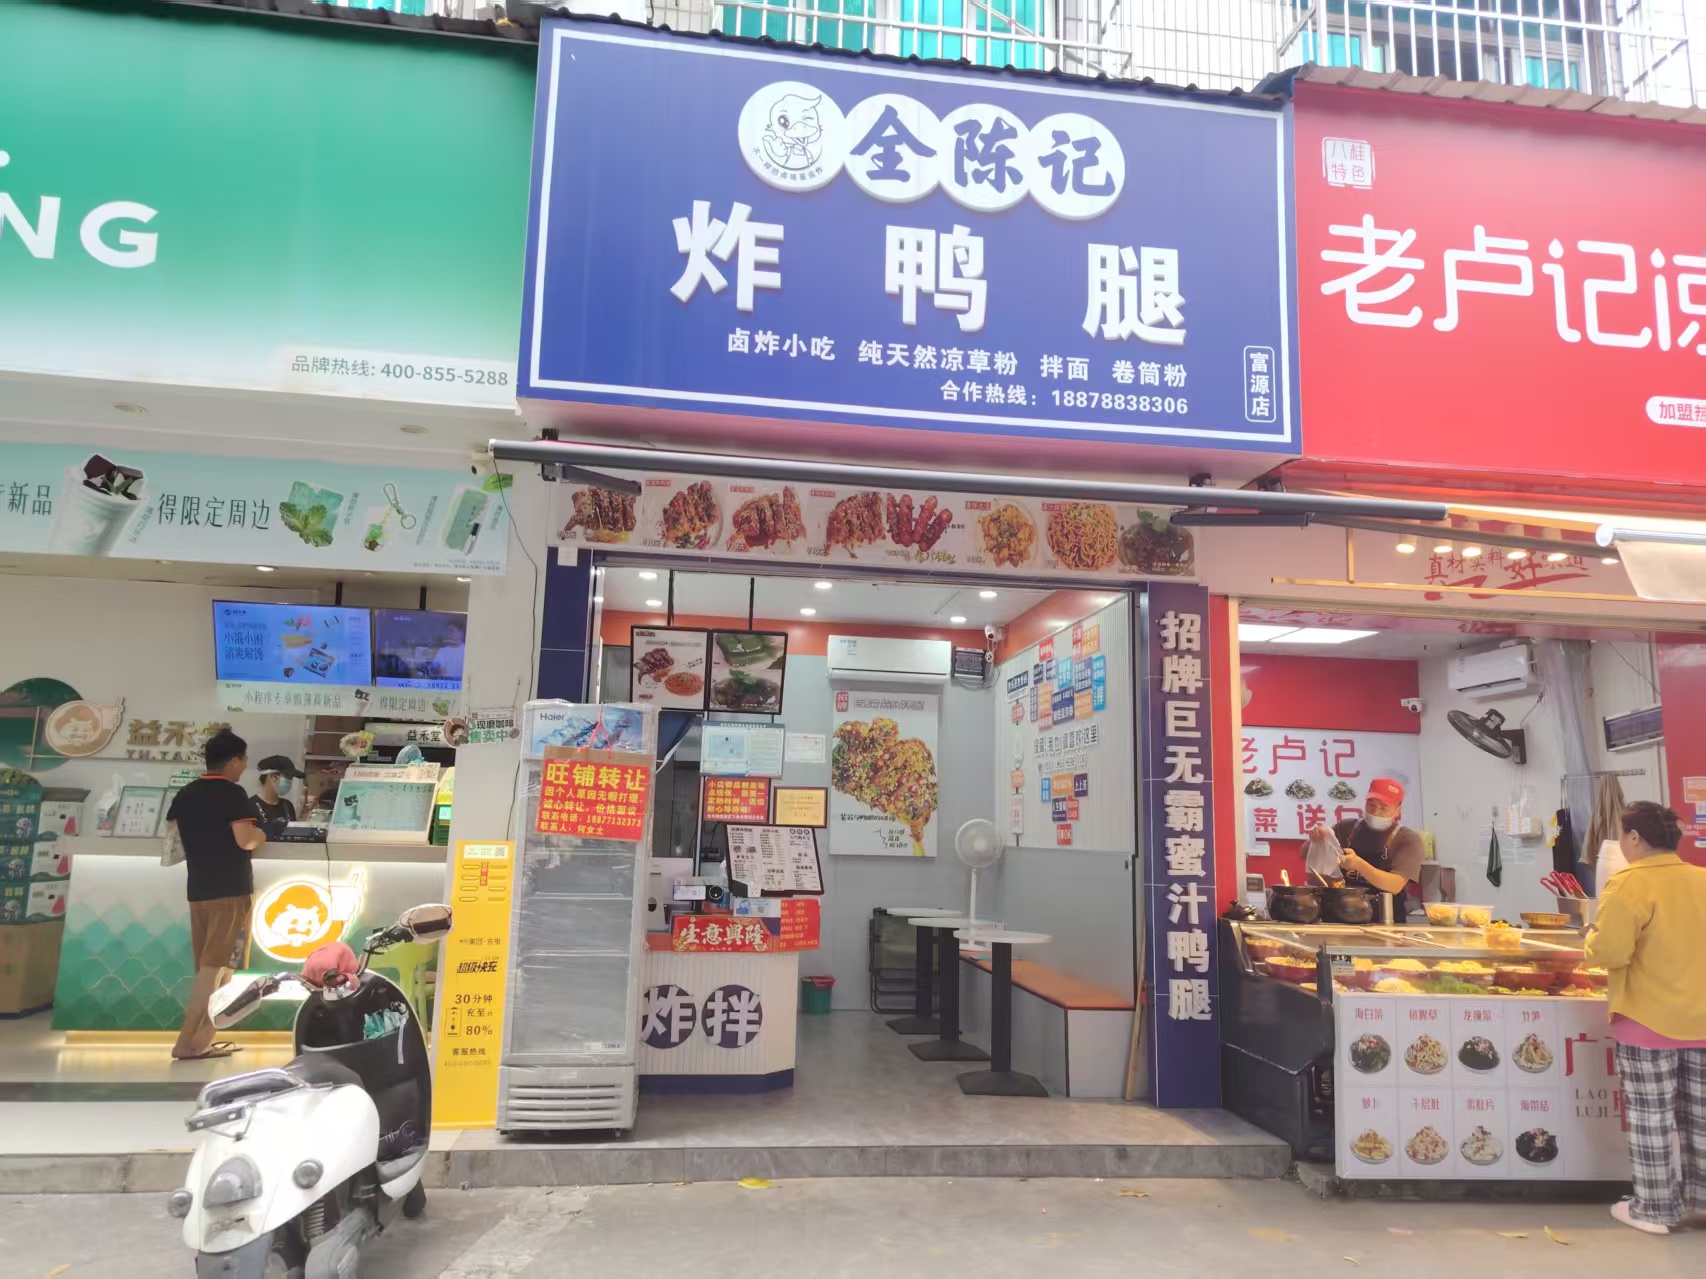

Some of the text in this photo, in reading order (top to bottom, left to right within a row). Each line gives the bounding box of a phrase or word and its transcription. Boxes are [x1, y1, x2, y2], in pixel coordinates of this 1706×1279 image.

[849, 104, 1116, 197] 全陈记
[1331, 163, 1366, 183] 特色
[670, 200, 1187, 345] 炸鸭腿
[291, 355, 509, 386] 品牌热线: 400-855-5288
[728, 328, 1187, 388] 卤炸小吃 纯天然凉草粉 拌面 卷筒粉
[940, 379, 1189, 414] 合作热线： 18878838306
[1250, 352, 1271, 417] 富源店
[0, 482, 53, 517] 新品
[158, 493, 271, 530] 得限定周边
[540, 712, 565, 721] Haier
[407, 729, 442, 742] 益禾堂
[1242, 735, 1360, 778] 老卢记
[546, 763, 647, 791] 旺铺转让
[586, 815, 642, 828] 18877132373
[1160, 611, 1213, 1021] 招牌巨无霸蜜汁鸭腿
[680, 923, 765, 946] 生意興隆
[456, 960, 498, 974] 超级快充
[455, 993, 493, 1005] 30分钟
[465, 1024, 493, 1036] 80%
[452, 1047, 487, 1057] 客服热线
[1575, 1088, 1608, 1101] LAO
